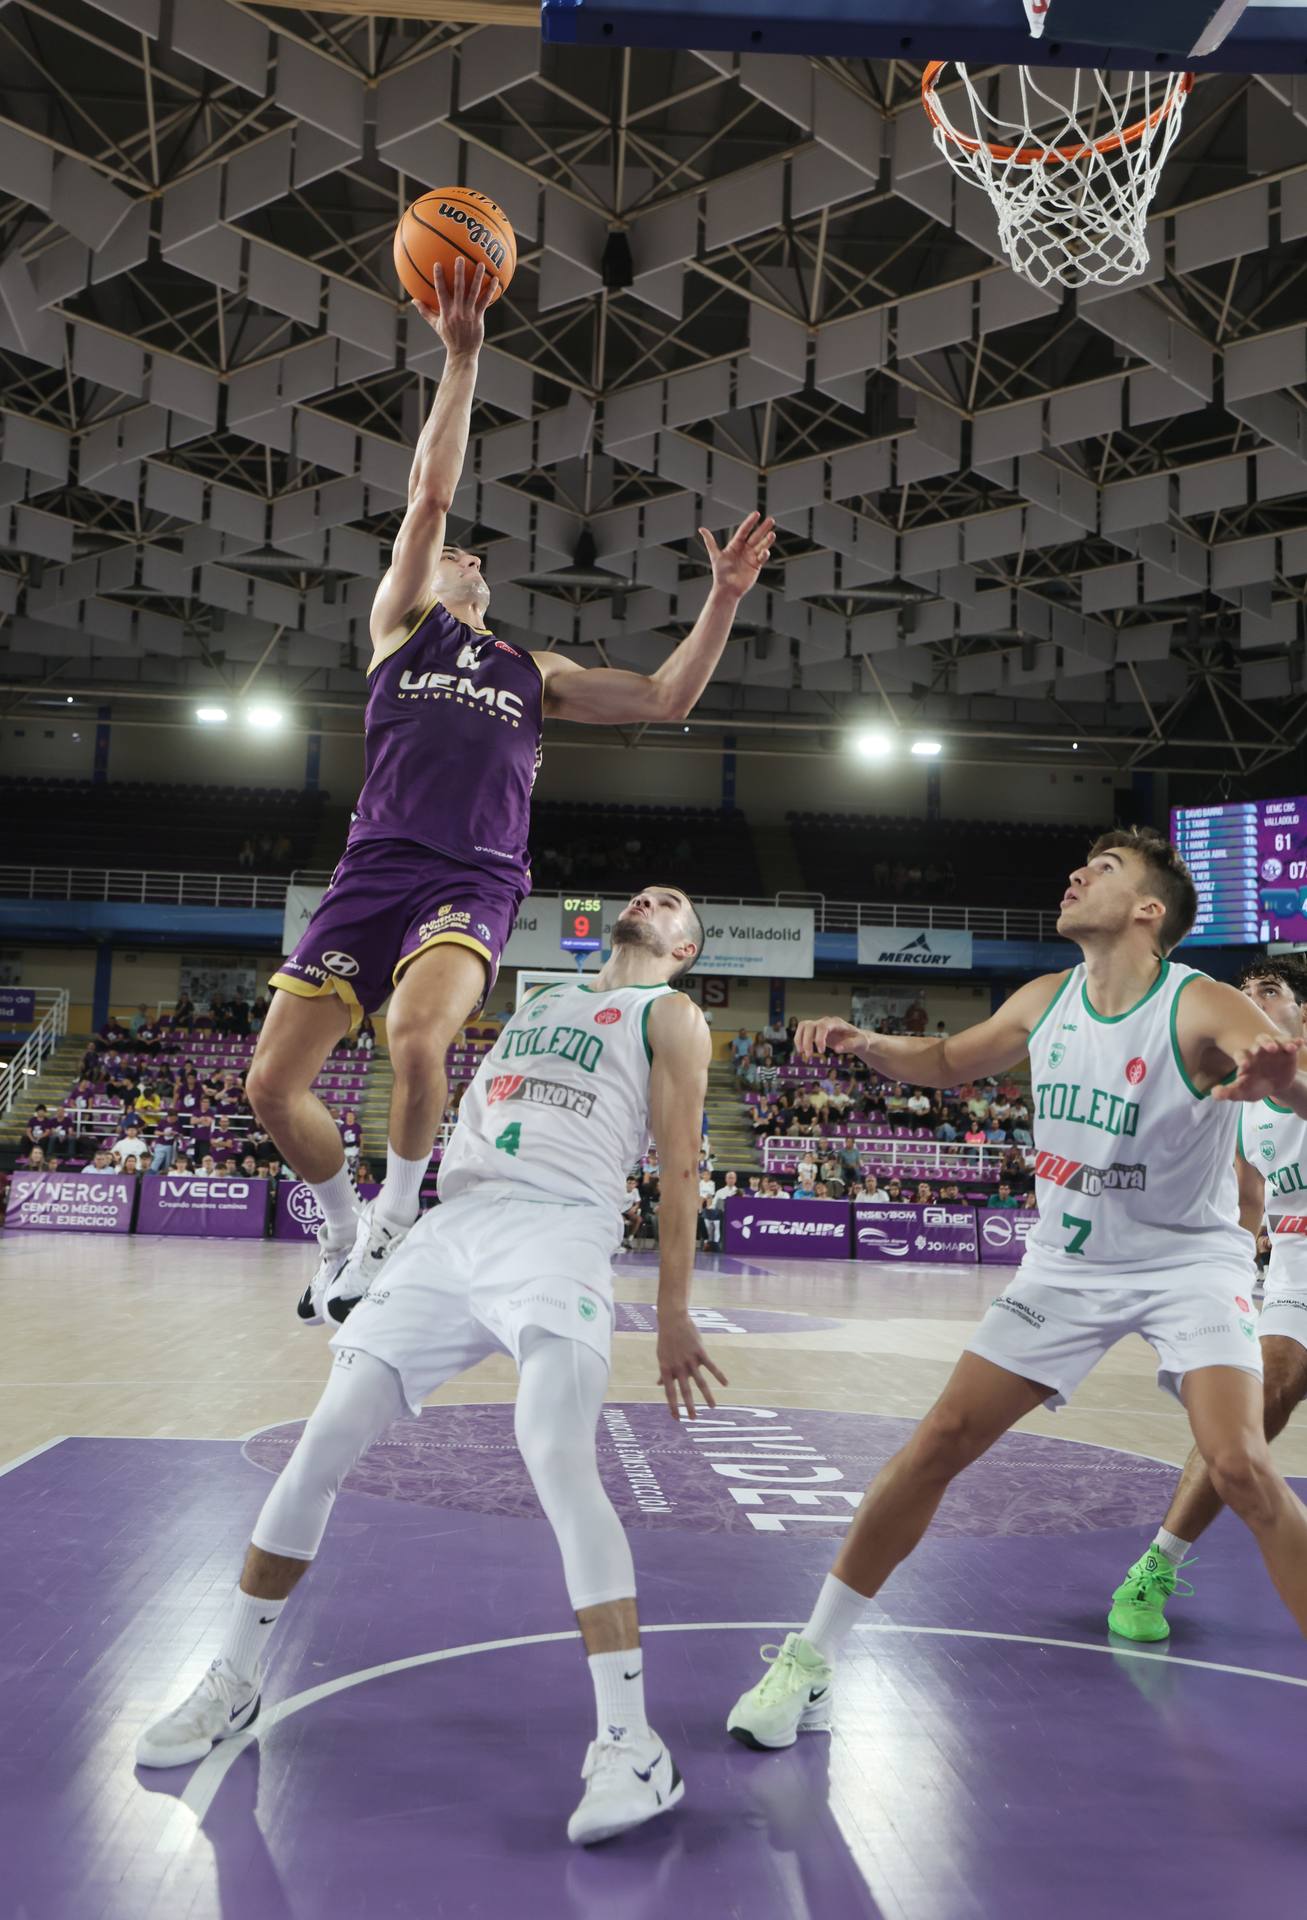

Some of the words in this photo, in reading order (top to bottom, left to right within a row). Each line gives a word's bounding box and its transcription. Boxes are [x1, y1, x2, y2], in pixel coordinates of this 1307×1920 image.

[438, 203, 506, 270] Wilson
[399, 670, 524, 718] UEMC
[398, 692, 519, 728] UNIVERSIDAD
[1275, 833, 1291, 851] 61
[1289, 861, 1307, 879] 07
[564, 899, 601, 912] 07:55
[574, 915, 590, 937] 9
[705, 926, 724, 938] de
[729, 926, 801, 941] Valladolid
[878, 952, 952, 965] MERCURY
[304, 964, 332, 981] HYU
[501, 1026, 604, 1073] TOLEDO
[1036, 1083, 1140, 1137] TOLEDO
[495, 1122, 522, 1157] 4
[1267, 1162, 1307, 1197] TOL
[159, 1181, 249, 1199] IVECO
[21, 1202, 69, 1213] CENTRO
[71, 1203, 118, 1215] MÉDICO
[158, 1201, 189, 1209] Creando
[20, 1214, 28, 1223] Y
[29, 1214, 54, 1224] DEL
[56, 1215, 117, 1227] EJERCICIO
[756, 1220, 845, 1237] TECNAIRE
[1062, 1213, 1092, 1256] 7
[927, 1241, 975, 1252] JOMAPO
